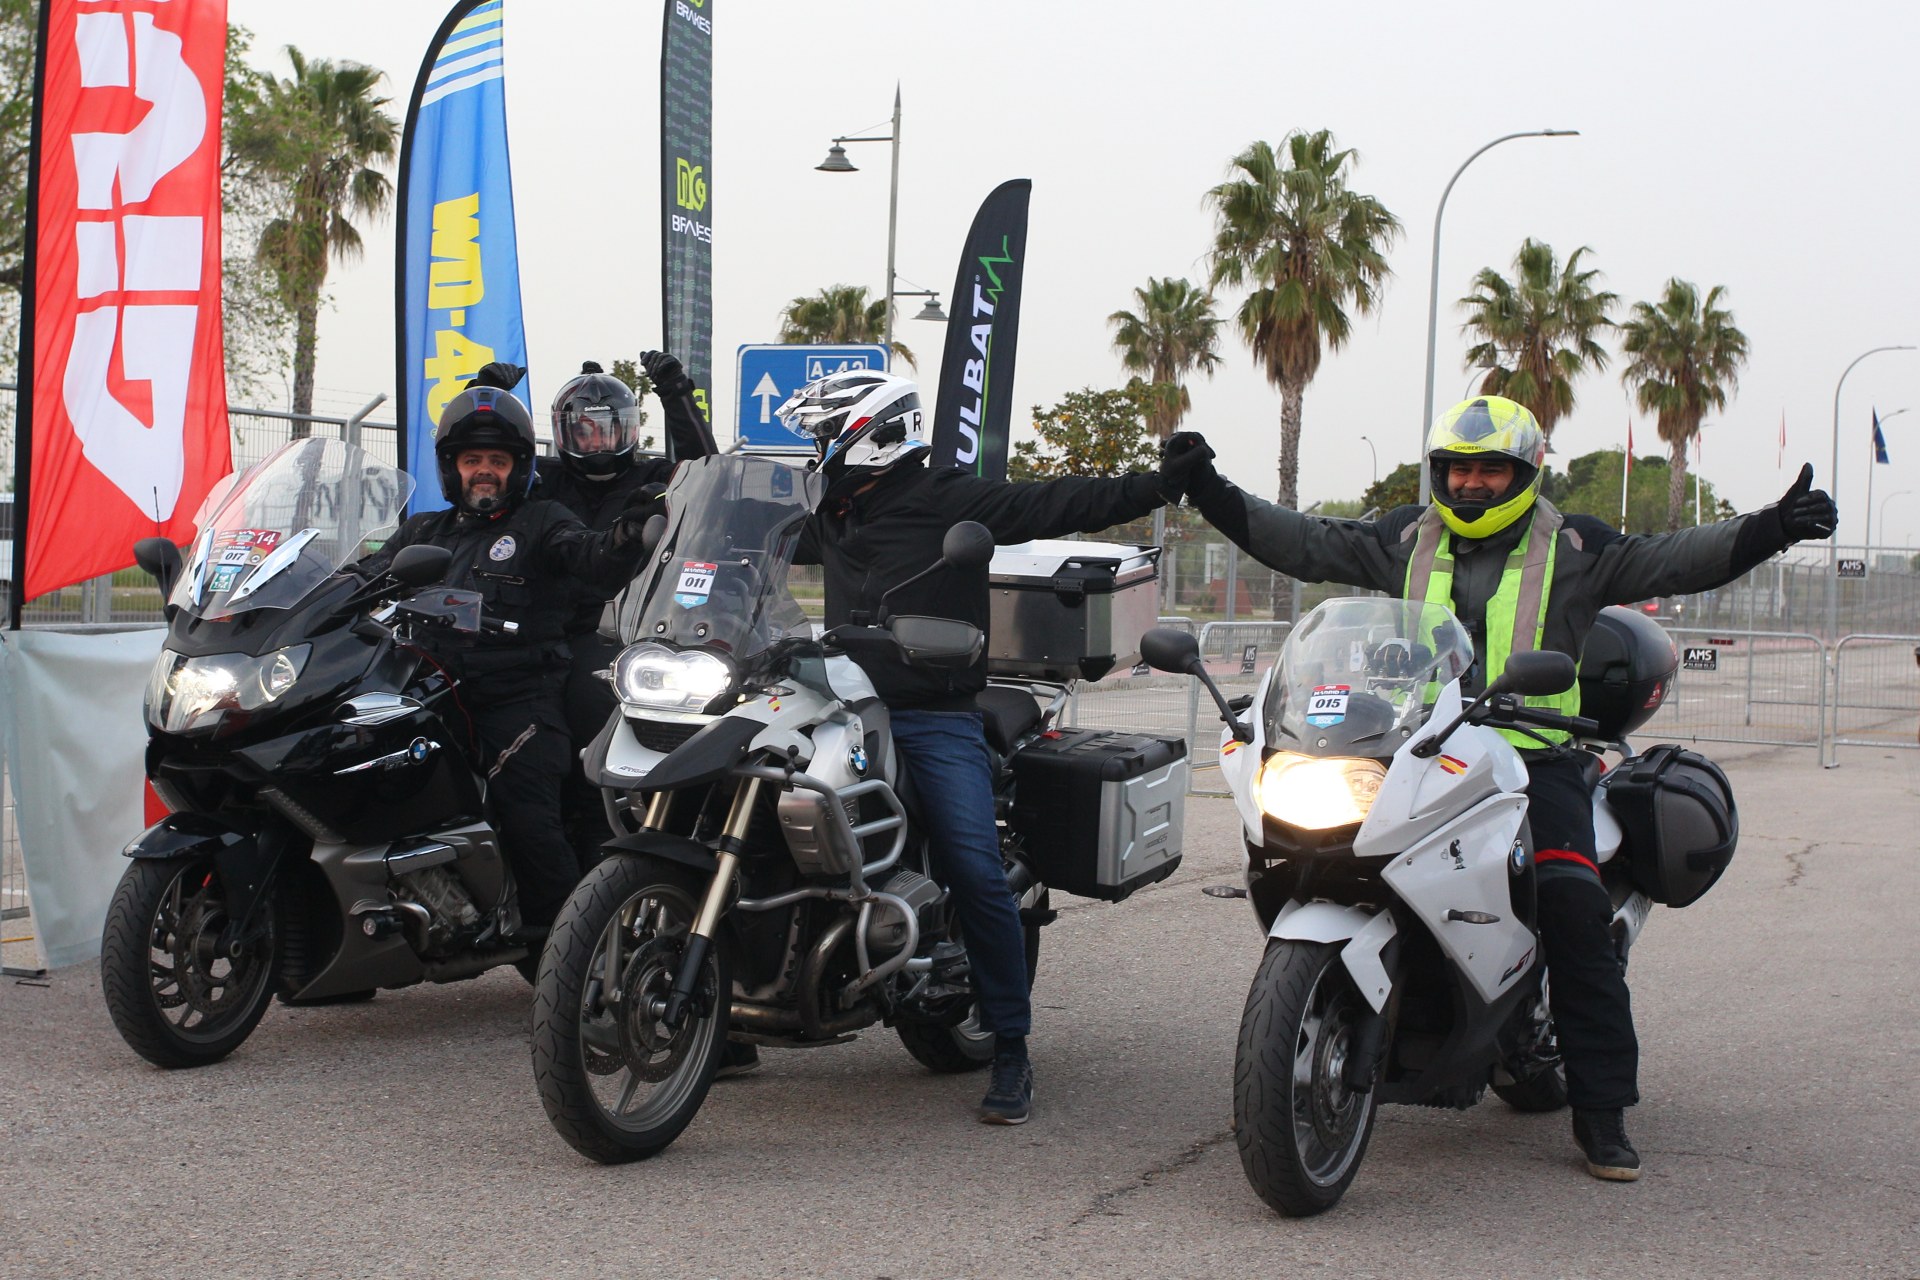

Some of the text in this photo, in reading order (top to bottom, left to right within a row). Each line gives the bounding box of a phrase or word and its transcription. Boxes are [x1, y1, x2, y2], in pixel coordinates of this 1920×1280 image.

[676, 0, 711, 35] BRAKES
[63, 0, 206, 521] GIV
[954, 283, 995, 467] ULBAT
[913, 412, 922, 432] R
[256, 531, 277, 546] 14
[225, 552, 246, 561] 017
[1842, 561, 1861, 571] AMS
[685, 577, 707, 588] 011
[1688, 649, 1712, 661] AMS
[1315, 699, 1341, 708] 015
